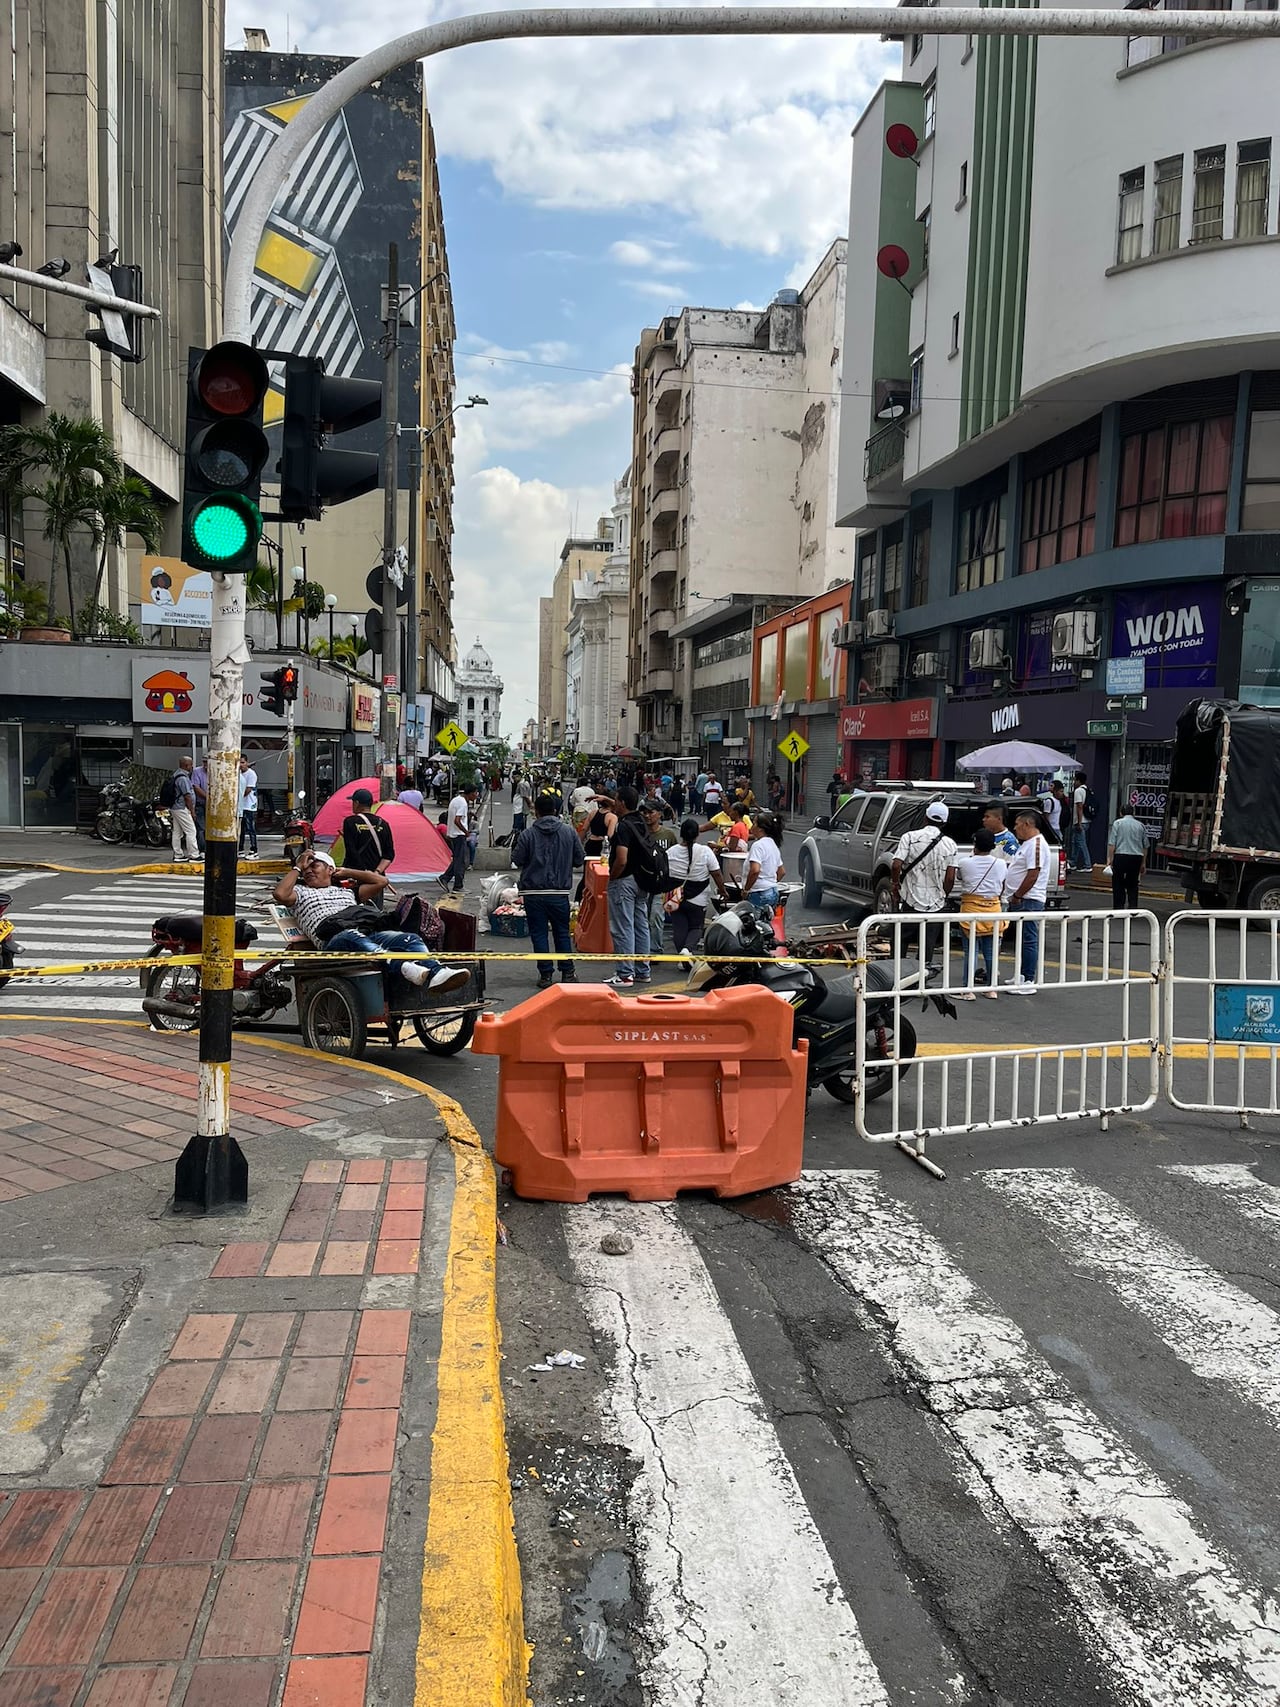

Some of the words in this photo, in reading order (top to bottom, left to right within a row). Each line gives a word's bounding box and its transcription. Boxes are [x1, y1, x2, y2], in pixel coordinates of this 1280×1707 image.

[1126, 605, 1204, 647] WOM
[1180, 637, 1204, 649] TODA!
[991, 703, 1020, 734] WOM
[843, 718, 862, 736] Claro
[1110, 723, 1119, 732] 10
[614, 1031, 680, 1041] SIPLAST
